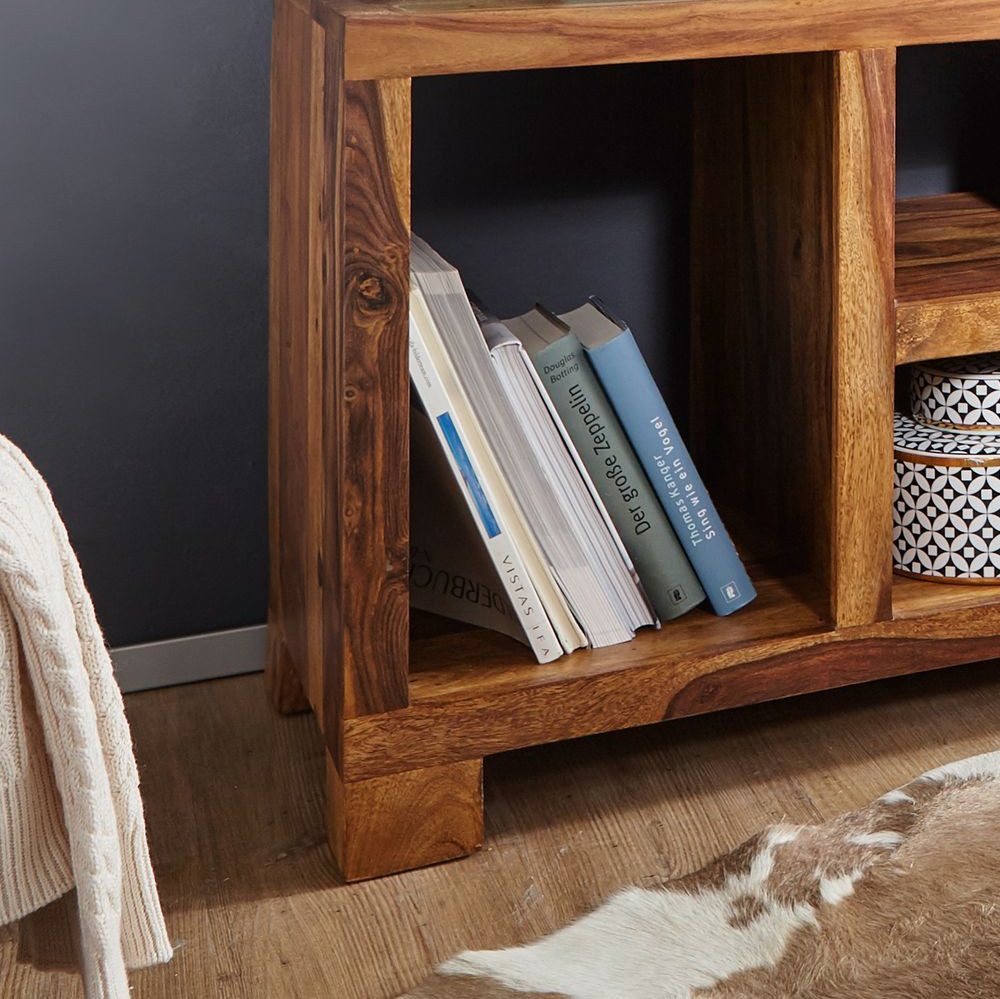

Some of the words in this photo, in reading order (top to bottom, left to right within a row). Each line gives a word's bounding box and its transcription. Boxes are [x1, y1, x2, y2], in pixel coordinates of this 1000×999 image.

[543, 351, 576, 375] Douglas
[549, 361, 580, 384] Botting
[568, 383, 612, 456] Zeppelin
[649, 415, 675, 456] Vogel
[604, 454, 640, 504] große
[653, 454, 681, 499] Kanger
[672, 457, 688, 481] ein
[684, 481, 700, 506] wie
[627, 505, 652, 537] Der
[675, 497, 703, 547] Thomas
[696, 506, 716, 540] Sing
[502, 554, 534, 617] VISTAS
